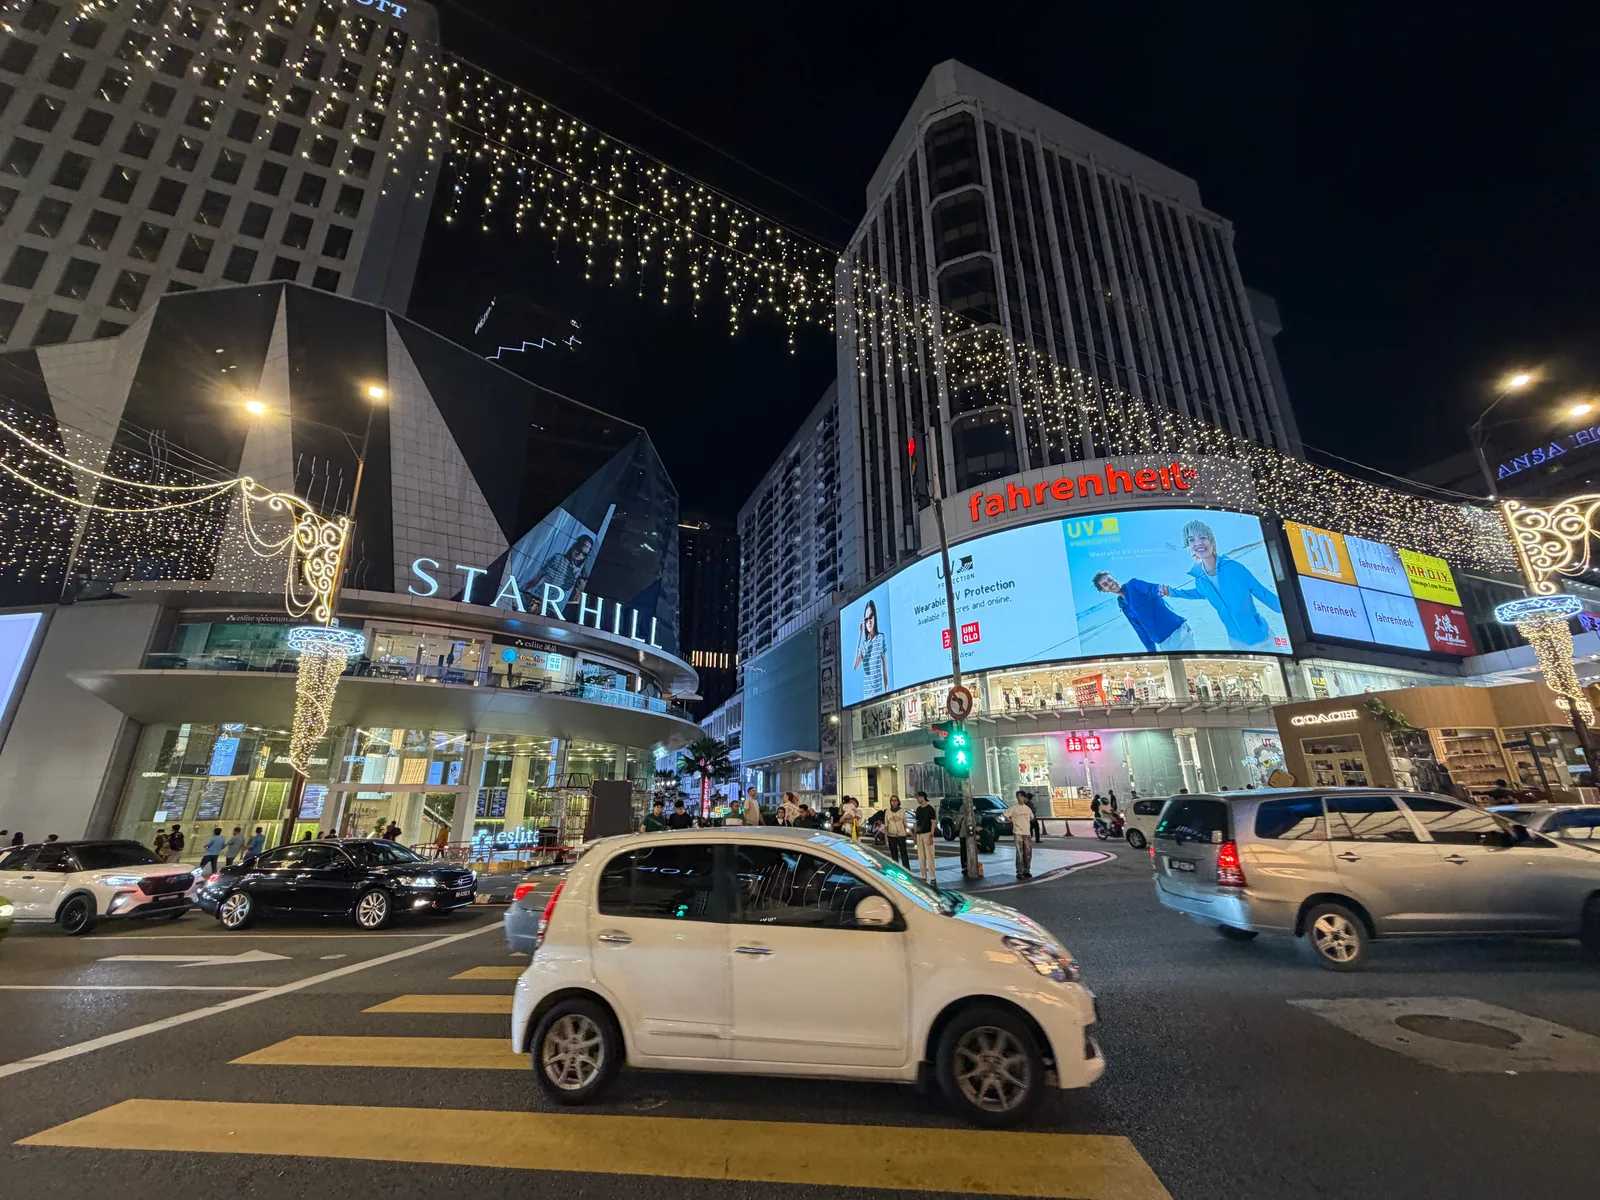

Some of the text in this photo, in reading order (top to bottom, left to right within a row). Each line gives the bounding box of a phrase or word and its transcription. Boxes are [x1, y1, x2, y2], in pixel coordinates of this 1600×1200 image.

[1497, 442, 1567, 481] ANSA
[968, 461, 1189, 523] fahrenheit
[1066, 519, 1095, 539] UV
[1358, 558, 1396, 575] fahrenheit
[937, 573, 975, 589] PRECTION
[408, 557, 663, 650] STARHILL
[914, 597, 946, 616] Wearable
[964, 580, 1016, 599] Protection
[917, 612, 940, 627] Available
[955, 605, 970, 614] ores
[971, 600, 985, 610] and
[987, 595, 1012, 606] online.
[1313, 600, 1357, 618] fahrenheit
[1375, 612, 1414, 628] fahrenheit
[962, 624, 977, 634] UNI
[524, 640, 544, 650] eslite
[963, 632, 979, 643] QLO
[907, 699, 918, 714] UT
[1290, 709, 1359, 727] COACH
[953, 734, 966, 746] 26
[1086, 737, 1098, 745] UNI
[1086, 743, 1100, 751] QLO
[1261, 738, 1272, 748] UT
